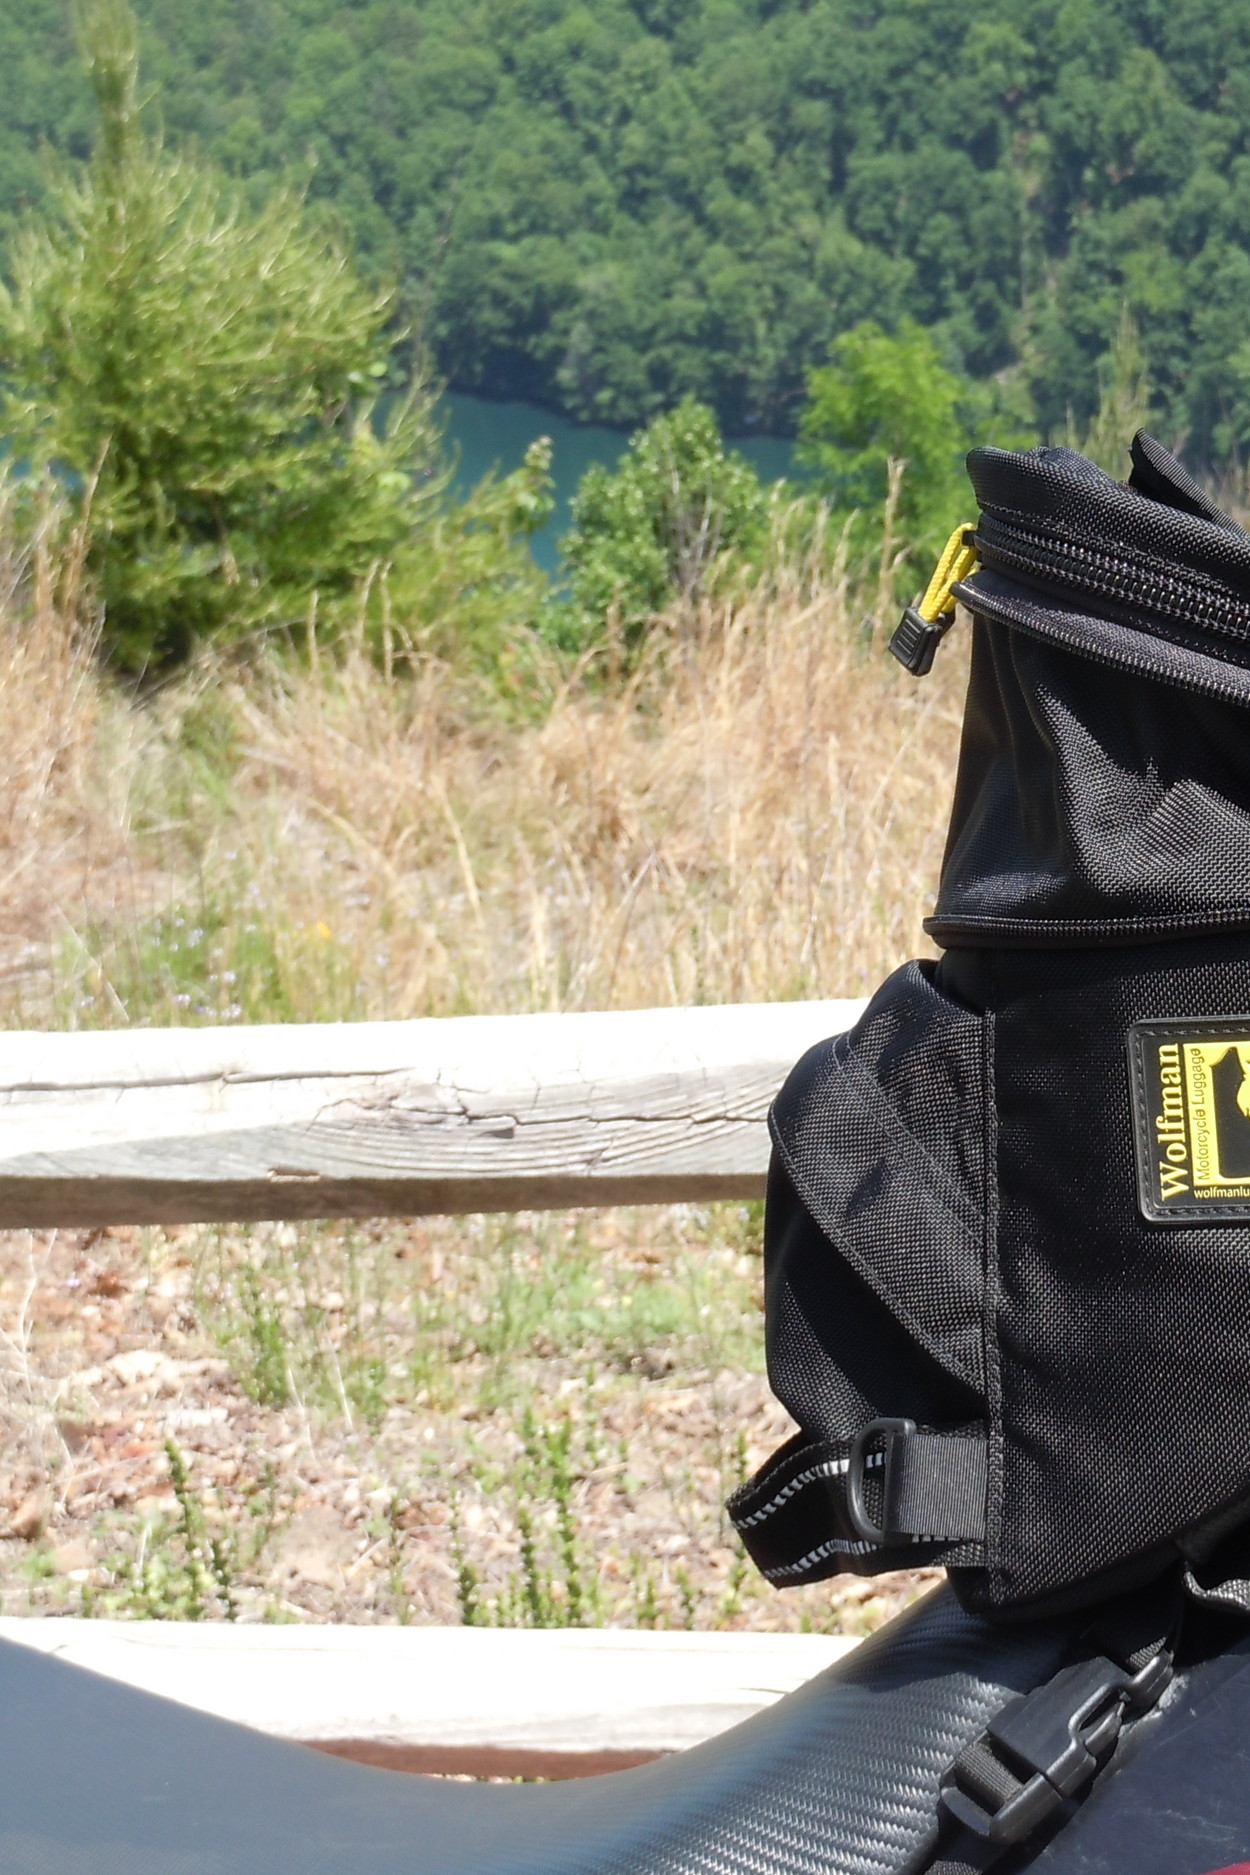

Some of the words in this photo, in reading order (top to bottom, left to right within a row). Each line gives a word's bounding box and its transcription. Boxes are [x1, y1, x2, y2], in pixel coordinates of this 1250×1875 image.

[1190, 1048, 1206, 1104] Luggage
[1156, 1043, 1189, 1201] Wolfman
[1191, 1109, 1212, 1180] Motorcycle
